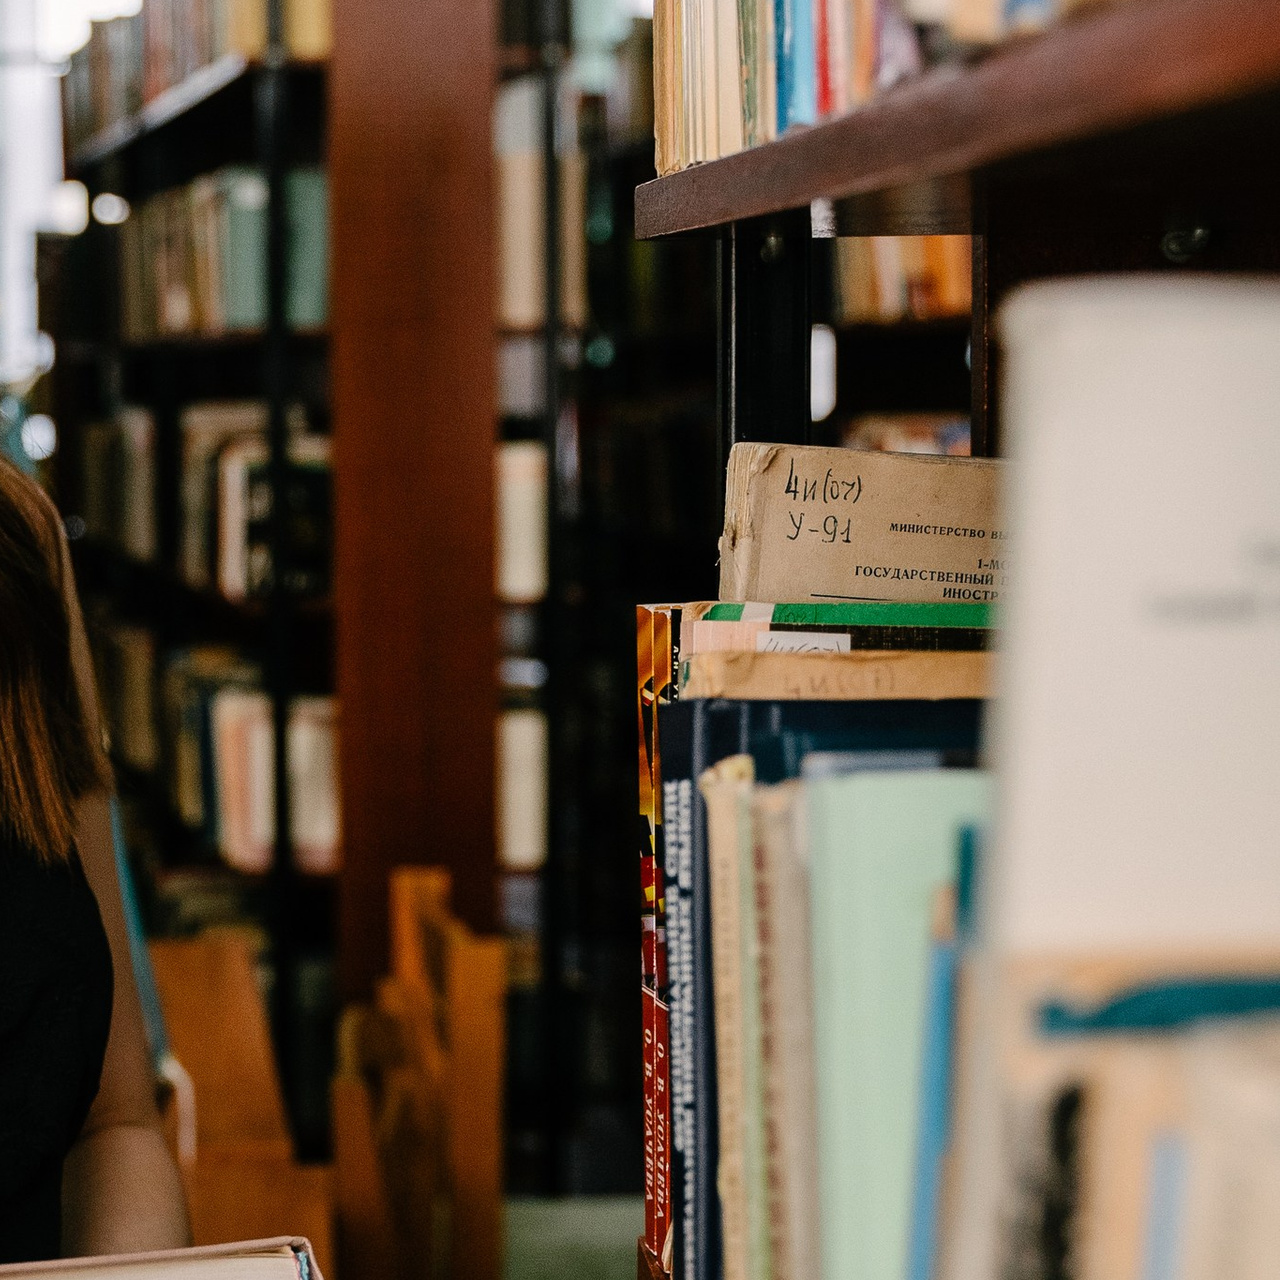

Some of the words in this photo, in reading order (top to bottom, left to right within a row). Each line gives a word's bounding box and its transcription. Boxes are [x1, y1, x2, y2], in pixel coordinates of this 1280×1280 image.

[890, 523, 986, 538] МИНИСТЕРСТВО
[855, 566, 994, 586] ГОСУДАРСТВЕННЫЙ
[644, 1028, 653, 1048] О.
[656, 1042, 665, 1062] О.
[644, 1062, 653, 1082] В.
[656, 1076, 665, 1096] В.
